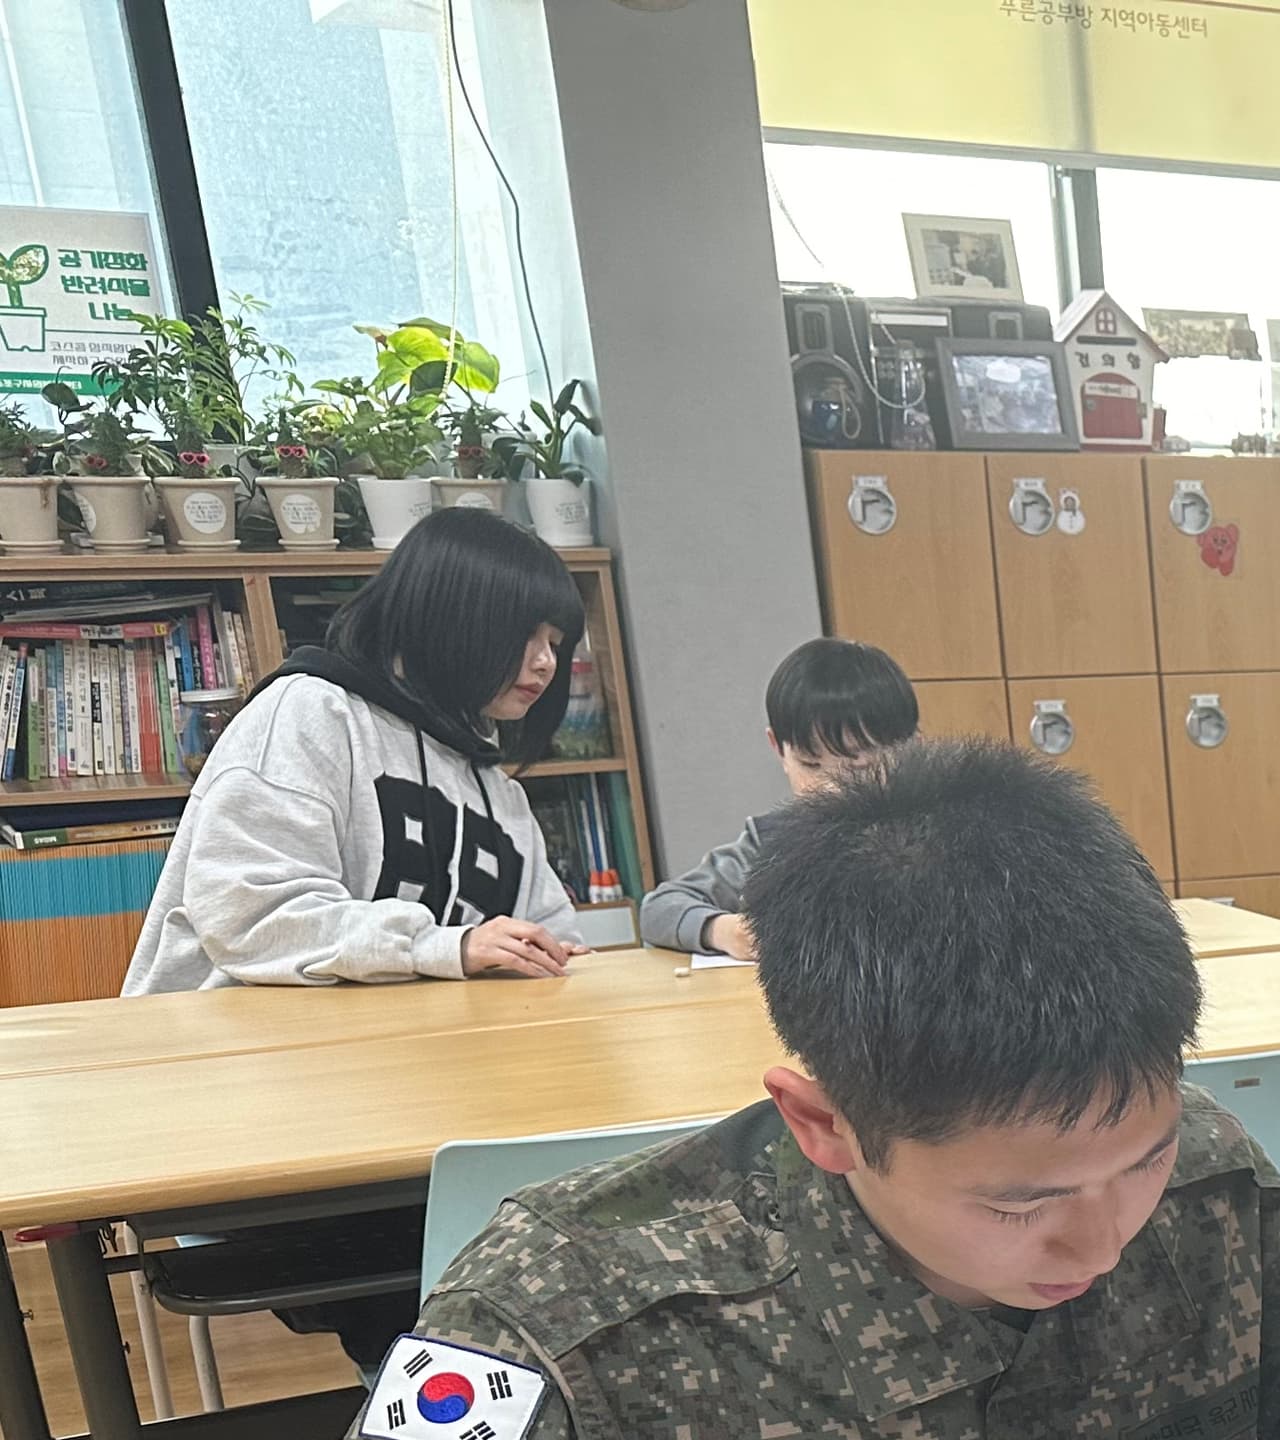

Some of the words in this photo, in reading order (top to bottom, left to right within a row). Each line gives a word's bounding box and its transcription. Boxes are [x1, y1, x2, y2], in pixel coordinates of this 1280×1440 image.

[1101, 8, 1208, 40] 지역아동센터
[57, 249, 148, 271] 공기정화
[61, 275, 150, 297] 반려식물
